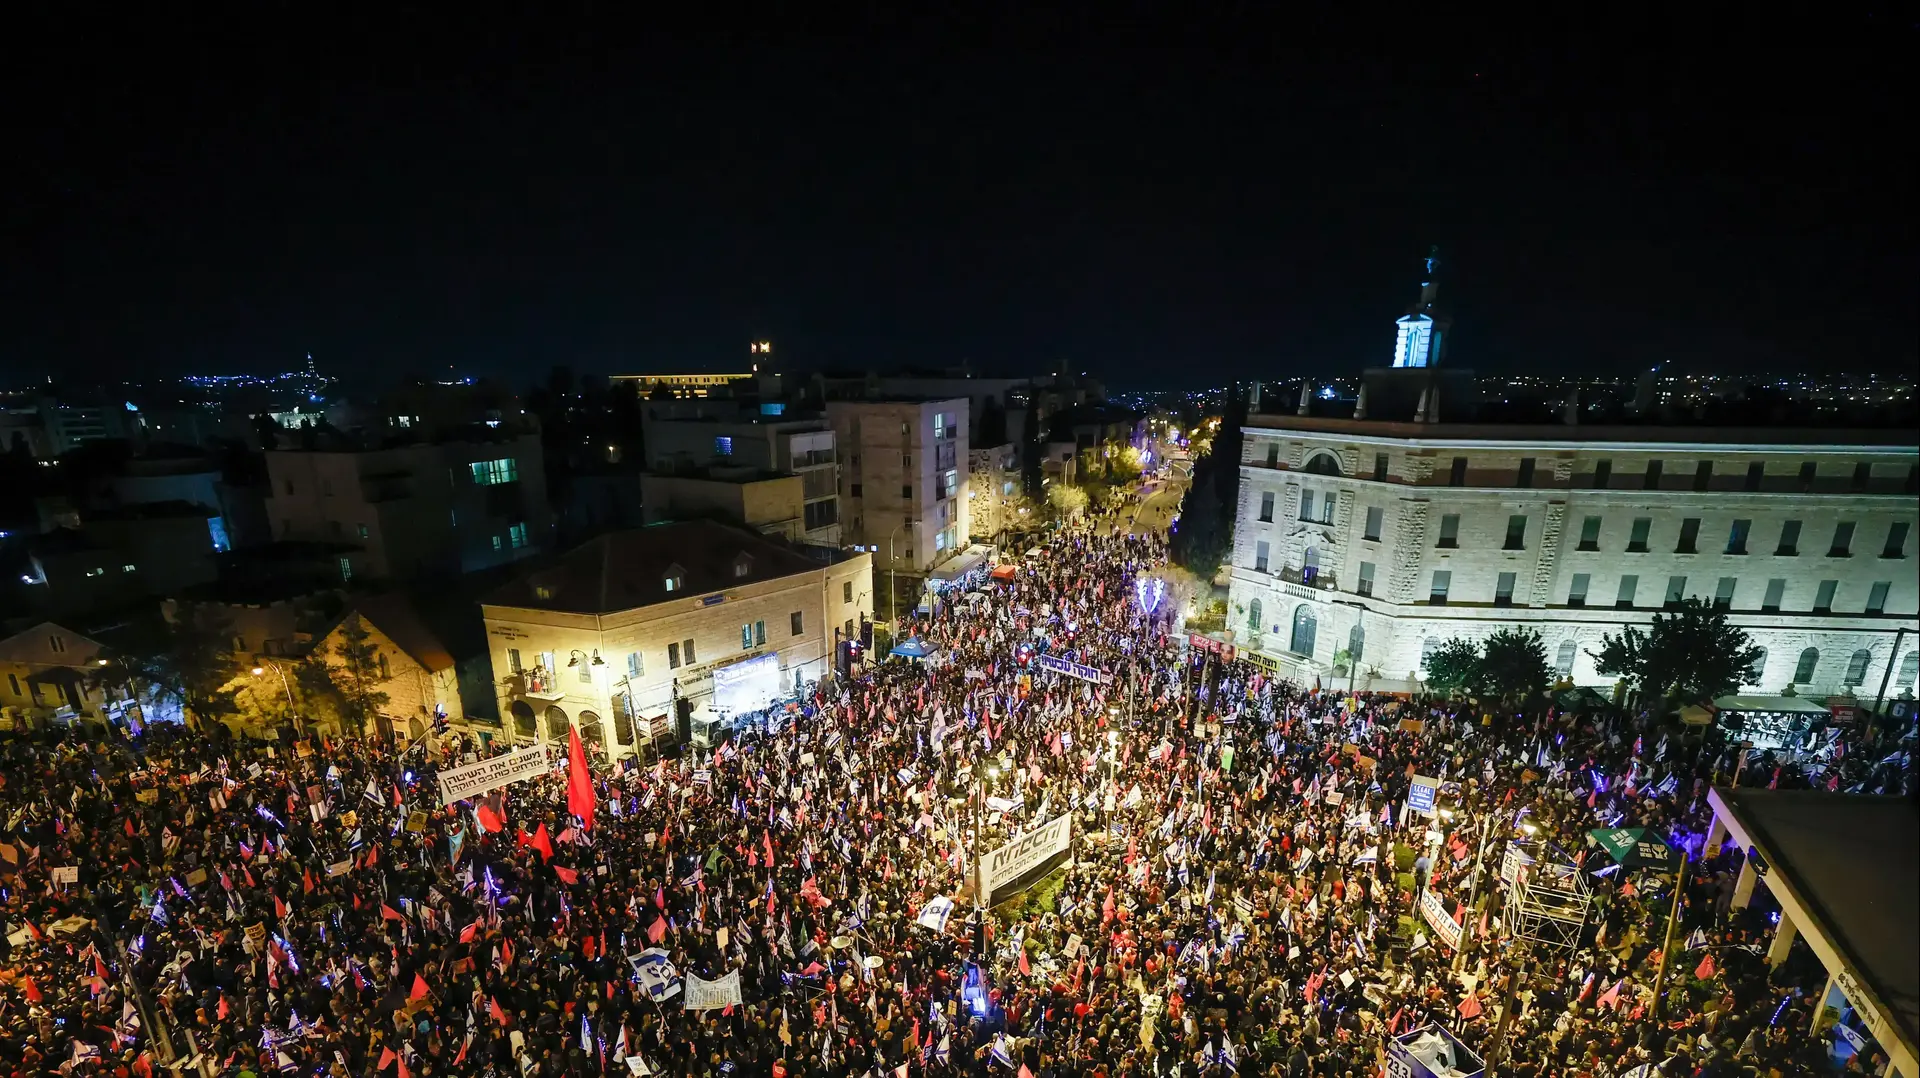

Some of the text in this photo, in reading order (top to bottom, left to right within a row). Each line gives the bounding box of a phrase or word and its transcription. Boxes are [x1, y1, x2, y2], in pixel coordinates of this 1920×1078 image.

[1073, 664, 1098, 680] חוקה
[447, 750, 540, 785] משנים את השיטה
[450, 759, 543, 793] אזרחים כותבים חוקה
